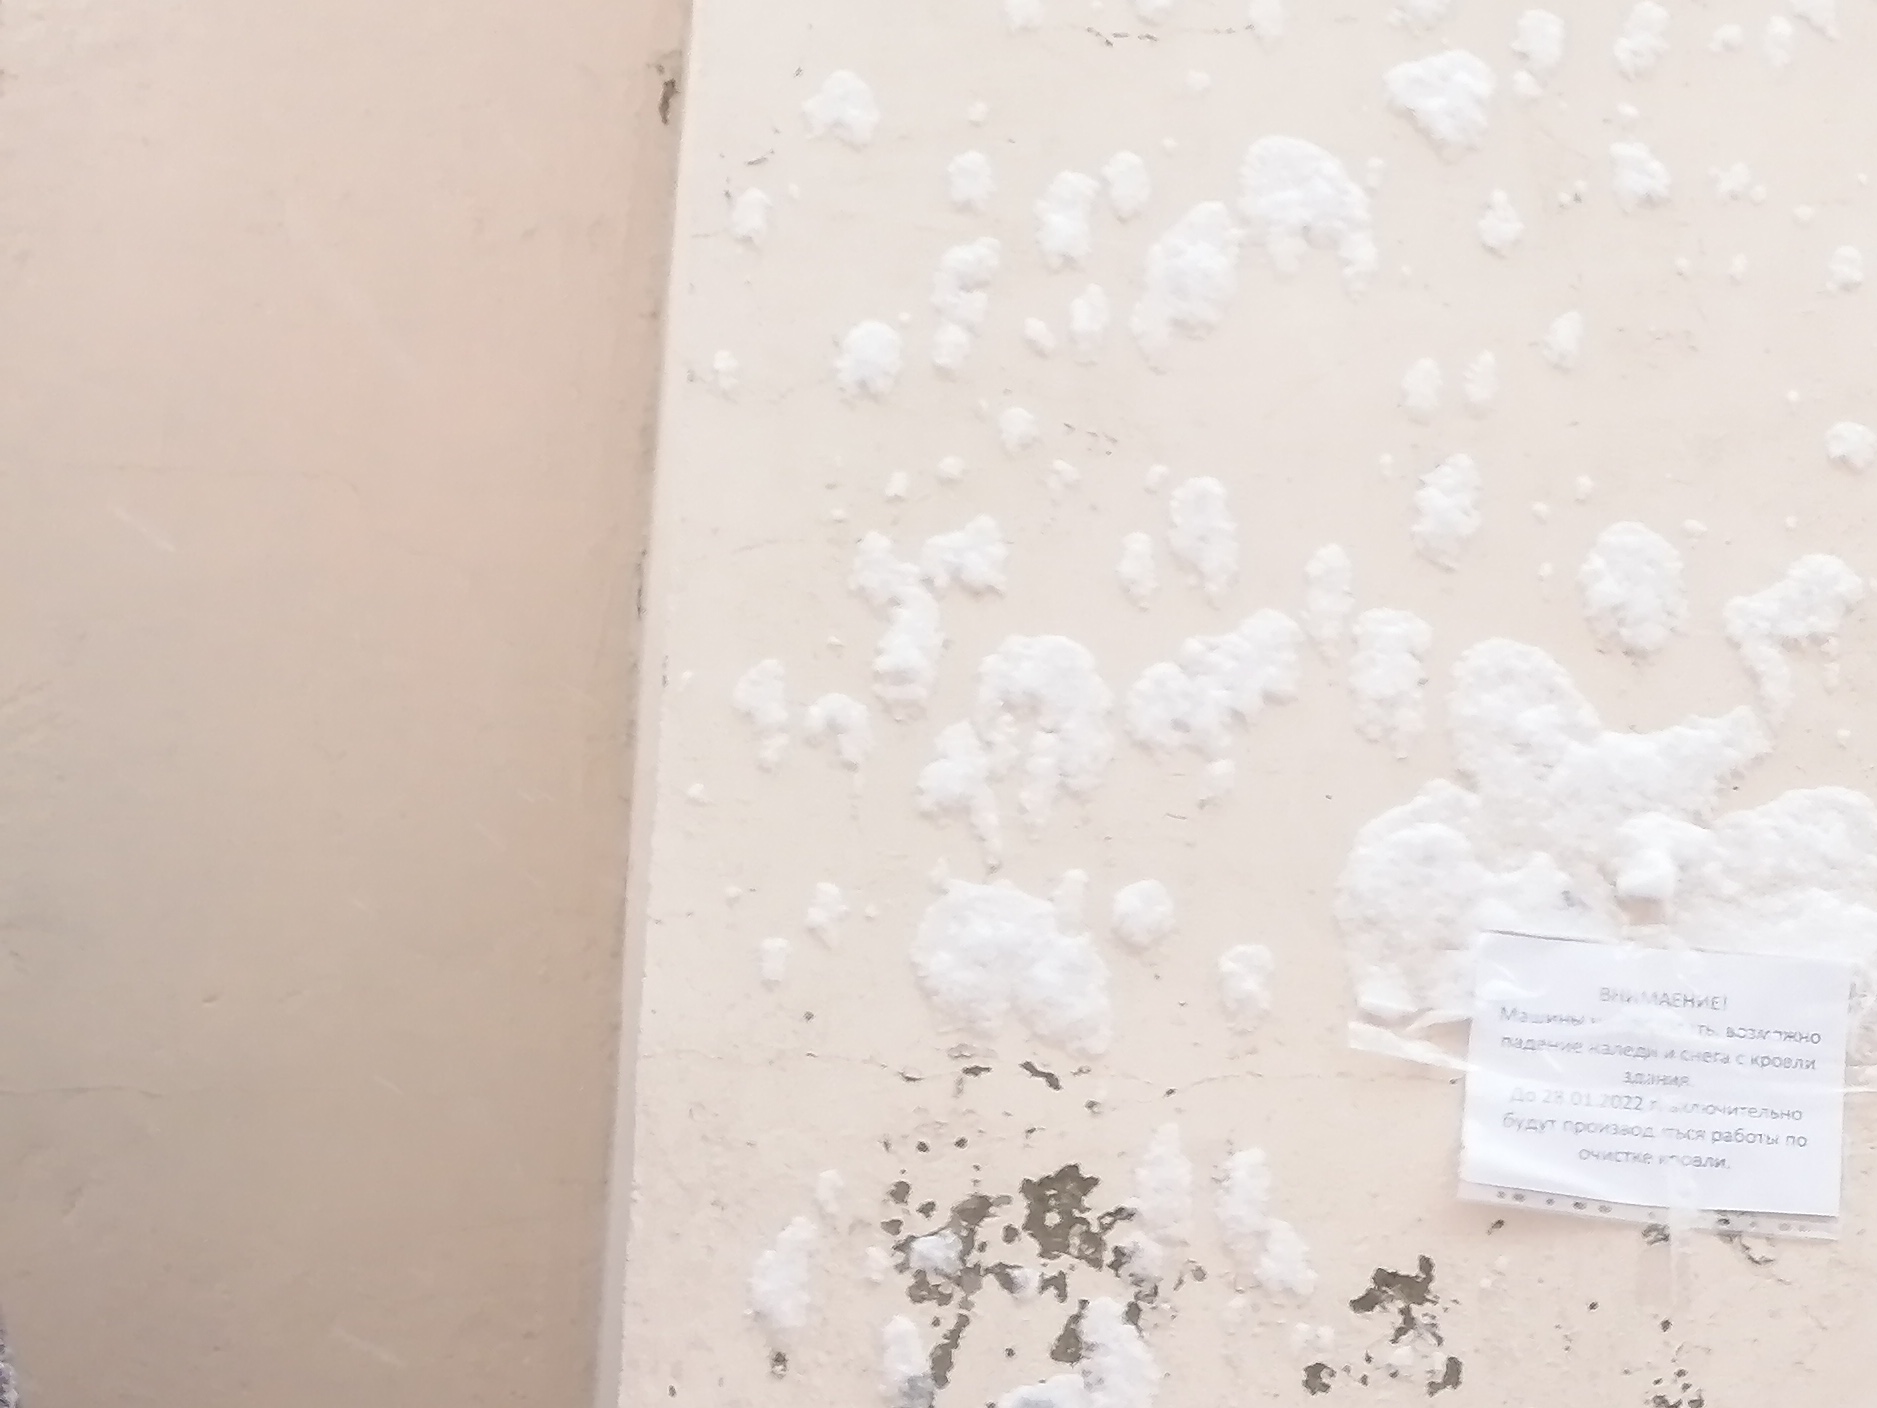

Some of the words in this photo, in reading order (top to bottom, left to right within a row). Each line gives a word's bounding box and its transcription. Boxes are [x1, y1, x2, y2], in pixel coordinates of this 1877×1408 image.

[1664, 1049, 1677, 1060] и
[1681, 1048, 1730, 1065] снега
[1735, 1054, 1744, 1065] с
[1750, 1056, 1817, 1073] кровли
[1509, 1087, 1537, 1103] До
[1502, 1112, 1556, 1132] будут
[1563, 1120, 1706, 1140] производться
[1711, 1128, 1779, 1146] работы
[1786, 1135, 1808, 1148] по
[1577, 1147, 1653, 1165] очистке
